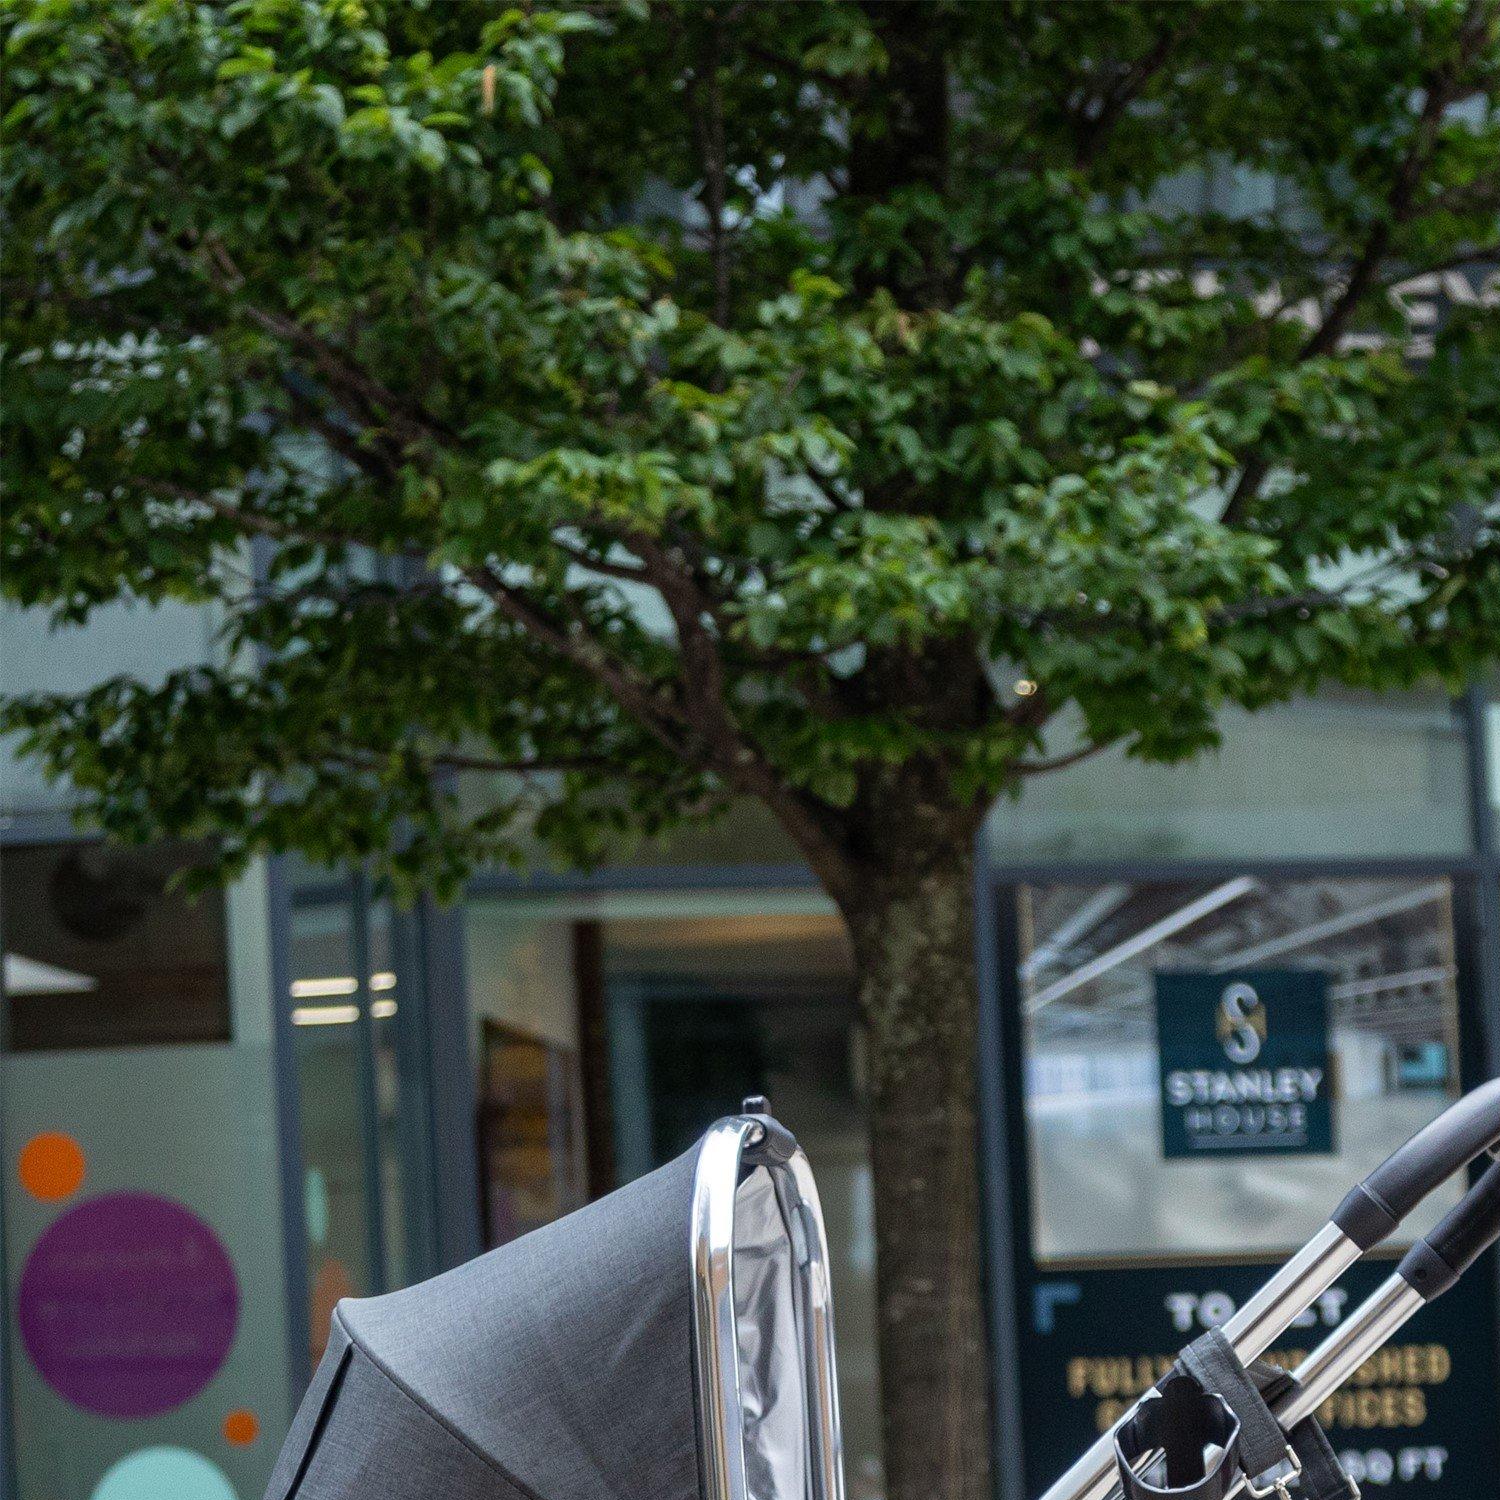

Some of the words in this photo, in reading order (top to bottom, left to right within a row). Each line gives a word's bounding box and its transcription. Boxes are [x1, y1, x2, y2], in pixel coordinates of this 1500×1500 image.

[1167, 1070, 1323, 1106] STANLEY
[1184, 1104, 1307, 1136] HOUSE
[1165, 1290, 1236, 1332] TO
[1398, 1446, 1449, 1482] FT
